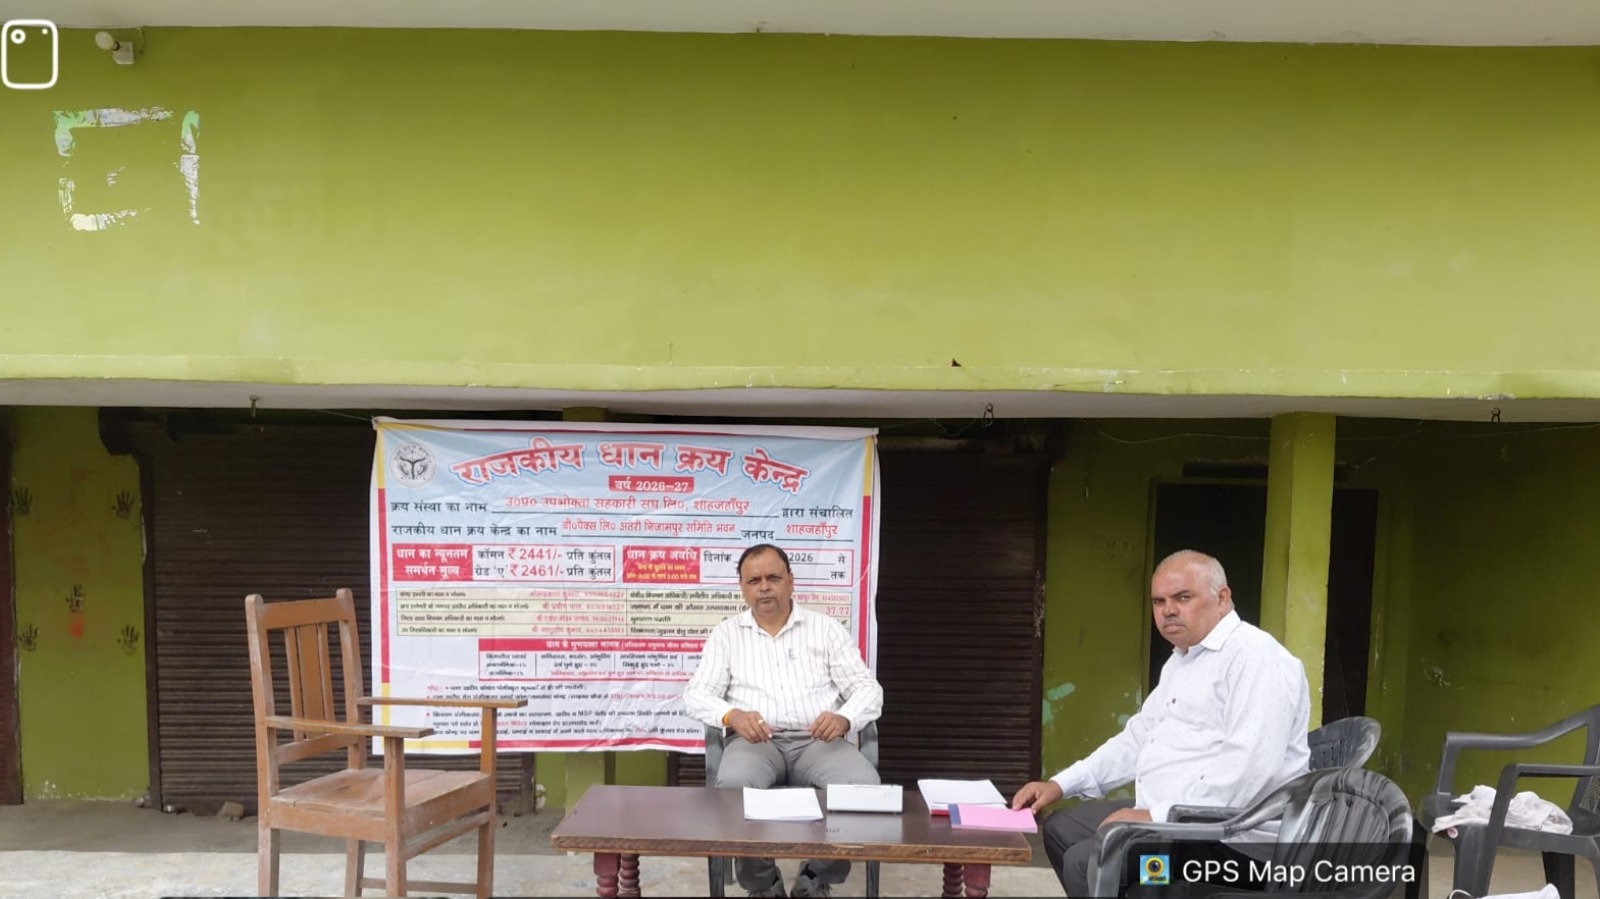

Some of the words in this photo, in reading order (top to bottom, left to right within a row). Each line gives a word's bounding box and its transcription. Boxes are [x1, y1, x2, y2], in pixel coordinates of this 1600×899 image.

[452, 436, 584, 483] राजकीय
[600, 441, 664, 468] धान
[675, 445, 732, 474] क्रय
[743, 447, 810, 493] केन्द्र
[614, 477, 632, 490] वर्ष
[636, 480, 689, 492] 2026-27
[390, 502, 409, 512] क्रय
[414, 500, 441, 512] संस्था
[445, 502, 460, 512] का
[465, 502, 487, 512] नाम
[542, 495, 589, 508] उपभोक्ता
[594, 496, 636, 508] सहकारी
[694, 497, 749, 514] शाहजहाँपुर
[782, 508, 805, 519] द्वारा
[809, 505, 853, 518] संचालित
[391, 521, 435, 535] राजकीय
[440, 526, 462, 535] धान
[466, 526, 485, 536] क्रय
[489, 523, 512, 536] केन्द्र
[516, 526, 530, 536] का
[535, 526, 557, 536] नाम
[686, 520, 712, 533] समिति
[716, 523, 736, 533] भवन
[741, 530, 775, 540] जनपद
[786, 522, 838, 538] शाहजहाँपुर
[397, 548, 416, 559] धान
[418, 548, 432, 559] का
[433, 548, 469, 563] न्यूनतम
[477, 547, 504, 559] कॉमन
[519, 548, 562, 560] 2441/-
[566, 548, 585, 560] प्रति
[588, 550, 611, 564] कुंतल
[627, 550, 646, 559] धान
[670, 547, 698, 560] अवधि
[704, 550, 732, 562] दिनांक
[838, 553, 846, 564] से
[404, 561, 437, 575] समर्थन
[438, 565, 460, 580] मूल्य
[474, 564, 490, 576] ग्रेड
[521, 565, 564, 577] 2461/-
[566, 565, 585, 576] प्रति
[588, 566, 612, 580] कुंतल
[830, 571, 846, 580] तक
